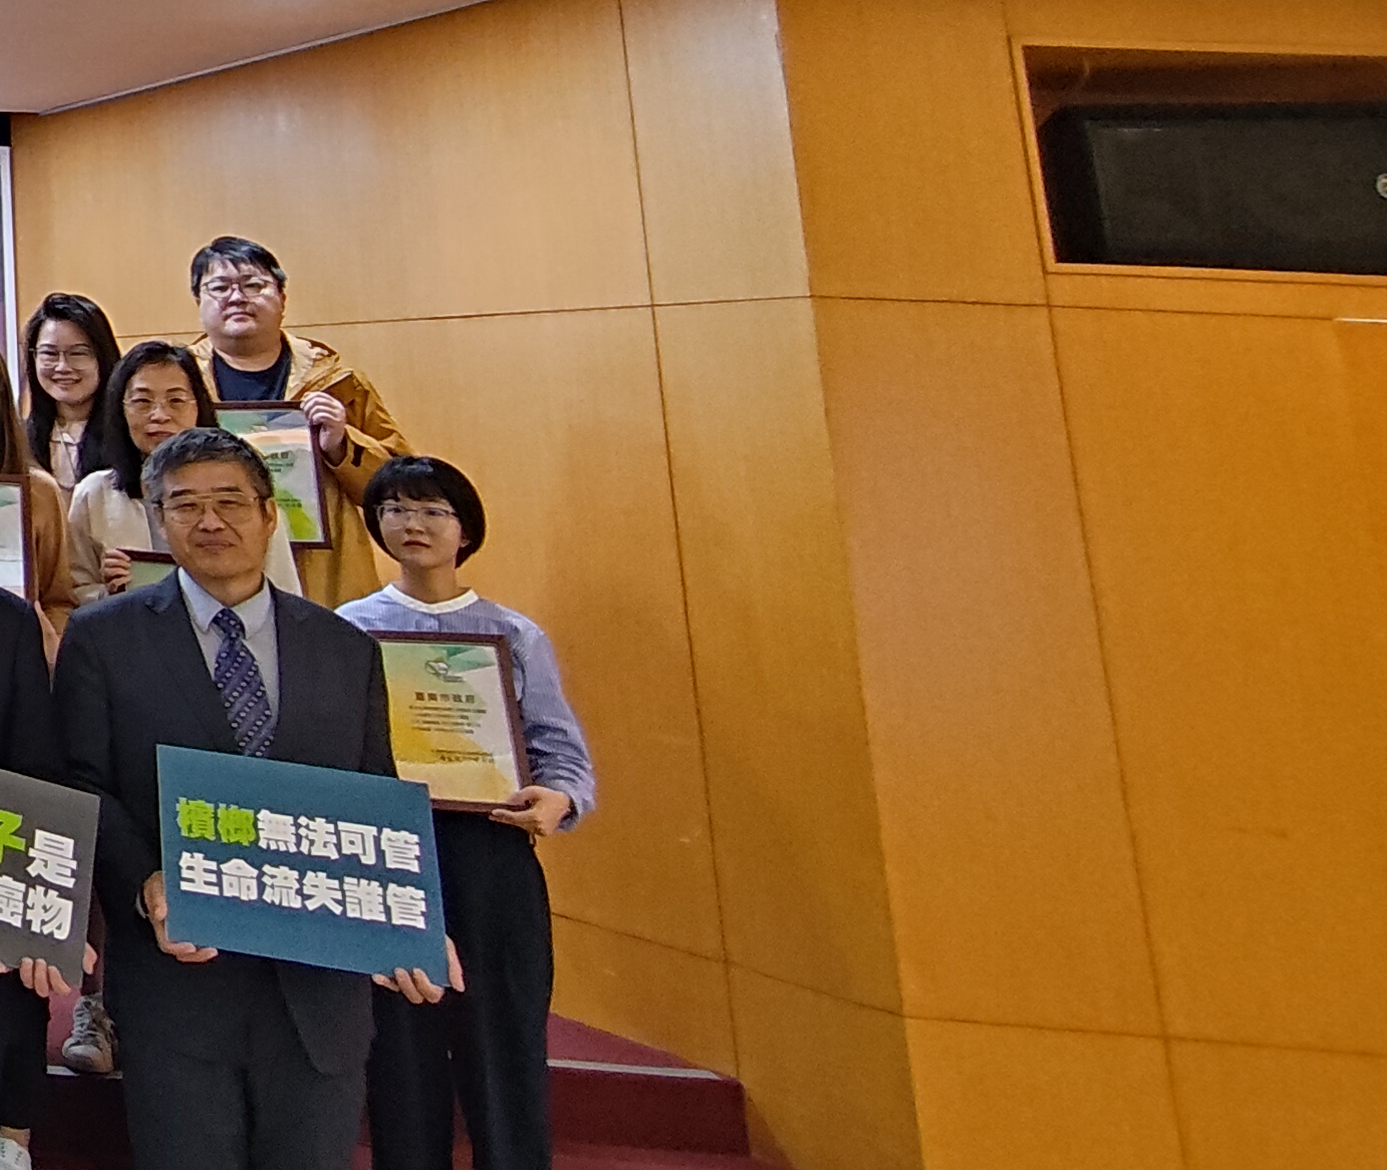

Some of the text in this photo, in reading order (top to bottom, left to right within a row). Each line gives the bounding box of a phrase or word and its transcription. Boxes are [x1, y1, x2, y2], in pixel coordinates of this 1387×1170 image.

[176, 797, 422, 874] 檳榔無法可管
[178, 851, 427, 930] 生命流失誰管
